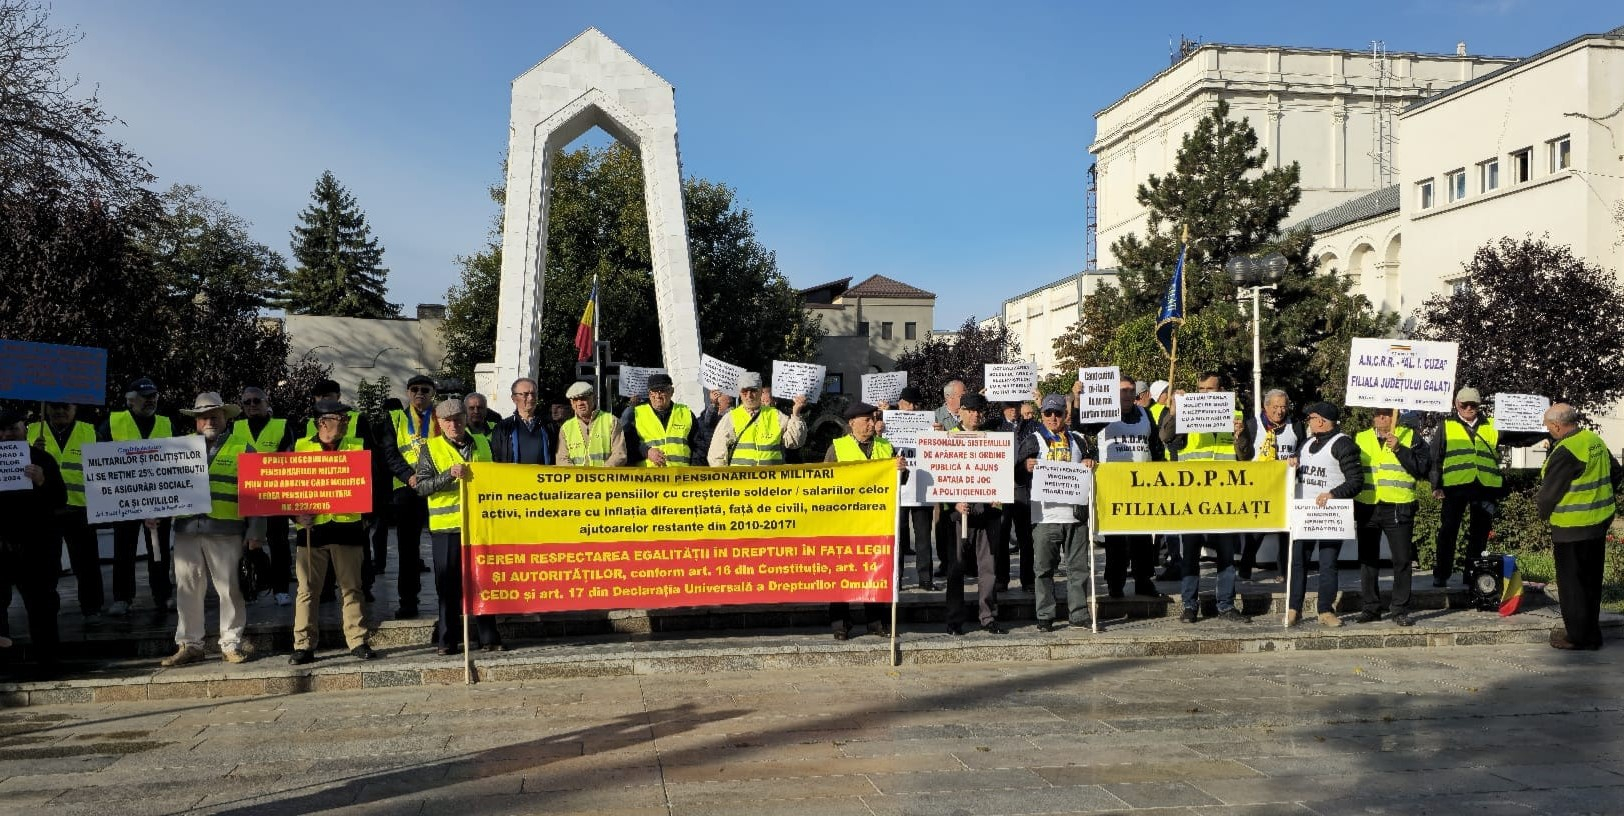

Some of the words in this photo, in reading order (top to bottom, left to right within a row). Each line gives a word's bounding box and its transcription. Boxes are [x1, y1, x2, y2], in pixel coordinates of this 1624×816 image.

[1351, 376, 1379, 388] FILIALA
[918, 438, 966, 447] PERSONALUL
[967, 438, 1011, 446] SISTEMULUI
[88, 456, 138, 467] MILITARILOR
[923, 451, 932, 459] DE
[978, 450, 1006, 459] ORDINE
[86, 473, 94, 482] LI
[96, 473, 106, 481] SE
[138, 469, 155, 478] 25%
[537, 474, 571, 483] STOP
[675, 470, 776, 483] PENSIONARILOR
[780, 469, 834, 479] MILITARI
[965, 476, 975, 484] DE
[976, 475, 991, 484] JOC
[1130, 469, 1254, 488] L.A.D.P.M.
[102, 487, 113, 495] DE
[158, 480, 194, 491] SOCIALE,
[478, 492, 503, 503] prin
[508, 490, 602, 501] neactualizarea
[606, 489, 659, 501] pensiilor
[664, 490, 678, 498] cu
[744, 486, 792, 497] soldelor
[796, 486, 800, 496] /
[803, 485, 855, 496] salariilor
[859, 485, 890, 495] celor
[932, 488, 938, 496] A
[939, 488, 997, 497] POLITICIENILOR
[119, 499, 130, 508] CA
[142, 495, 179, 507] CIVILILOR
[482, 508, 522, 519] activi,
[525, 507, 581, 518] indexare
[585, 509, 600, 517] cu
[757, 503, 772, 513] de
[775, 502, 808, 514] civili,
[811, 503, 886, 513] neacordarea
[1111, 502, 1193, 516] FILIALA
[1198, 500, 1271, 519] GALAȚI
[580, 524, 648, 536] ajutoarelor
[652, 522, 704, 532] restante
[708, 521, 726, 531] din
[476, 554, 526, 565] CEREM
[531, 551, 630, 564] RESPECTAREA
[732, 546, 798, 558] DREPTURI
[802, 543, 816, 556] ÎN
[820, 544, 853, 559] FAȚA
[856, 544, 890, 555] LEGII
[630, 567, 684, 578] conform
[688, 566, 712, 577] art.
[716, 566, 731, 576] 16
[735, 565, 754, 575] din
[836, 563, 858, 573] art.
[863, 562, 878, 572] 14
[480, 590, 520, 601] CEDO
[540, 589, 564, 600] art.
[569, 588, 585, 598] 17
[588, 586, 609, 597] din
[756, 584, 765, 592] a
[768, 580, 836, 592] Drepturilor
